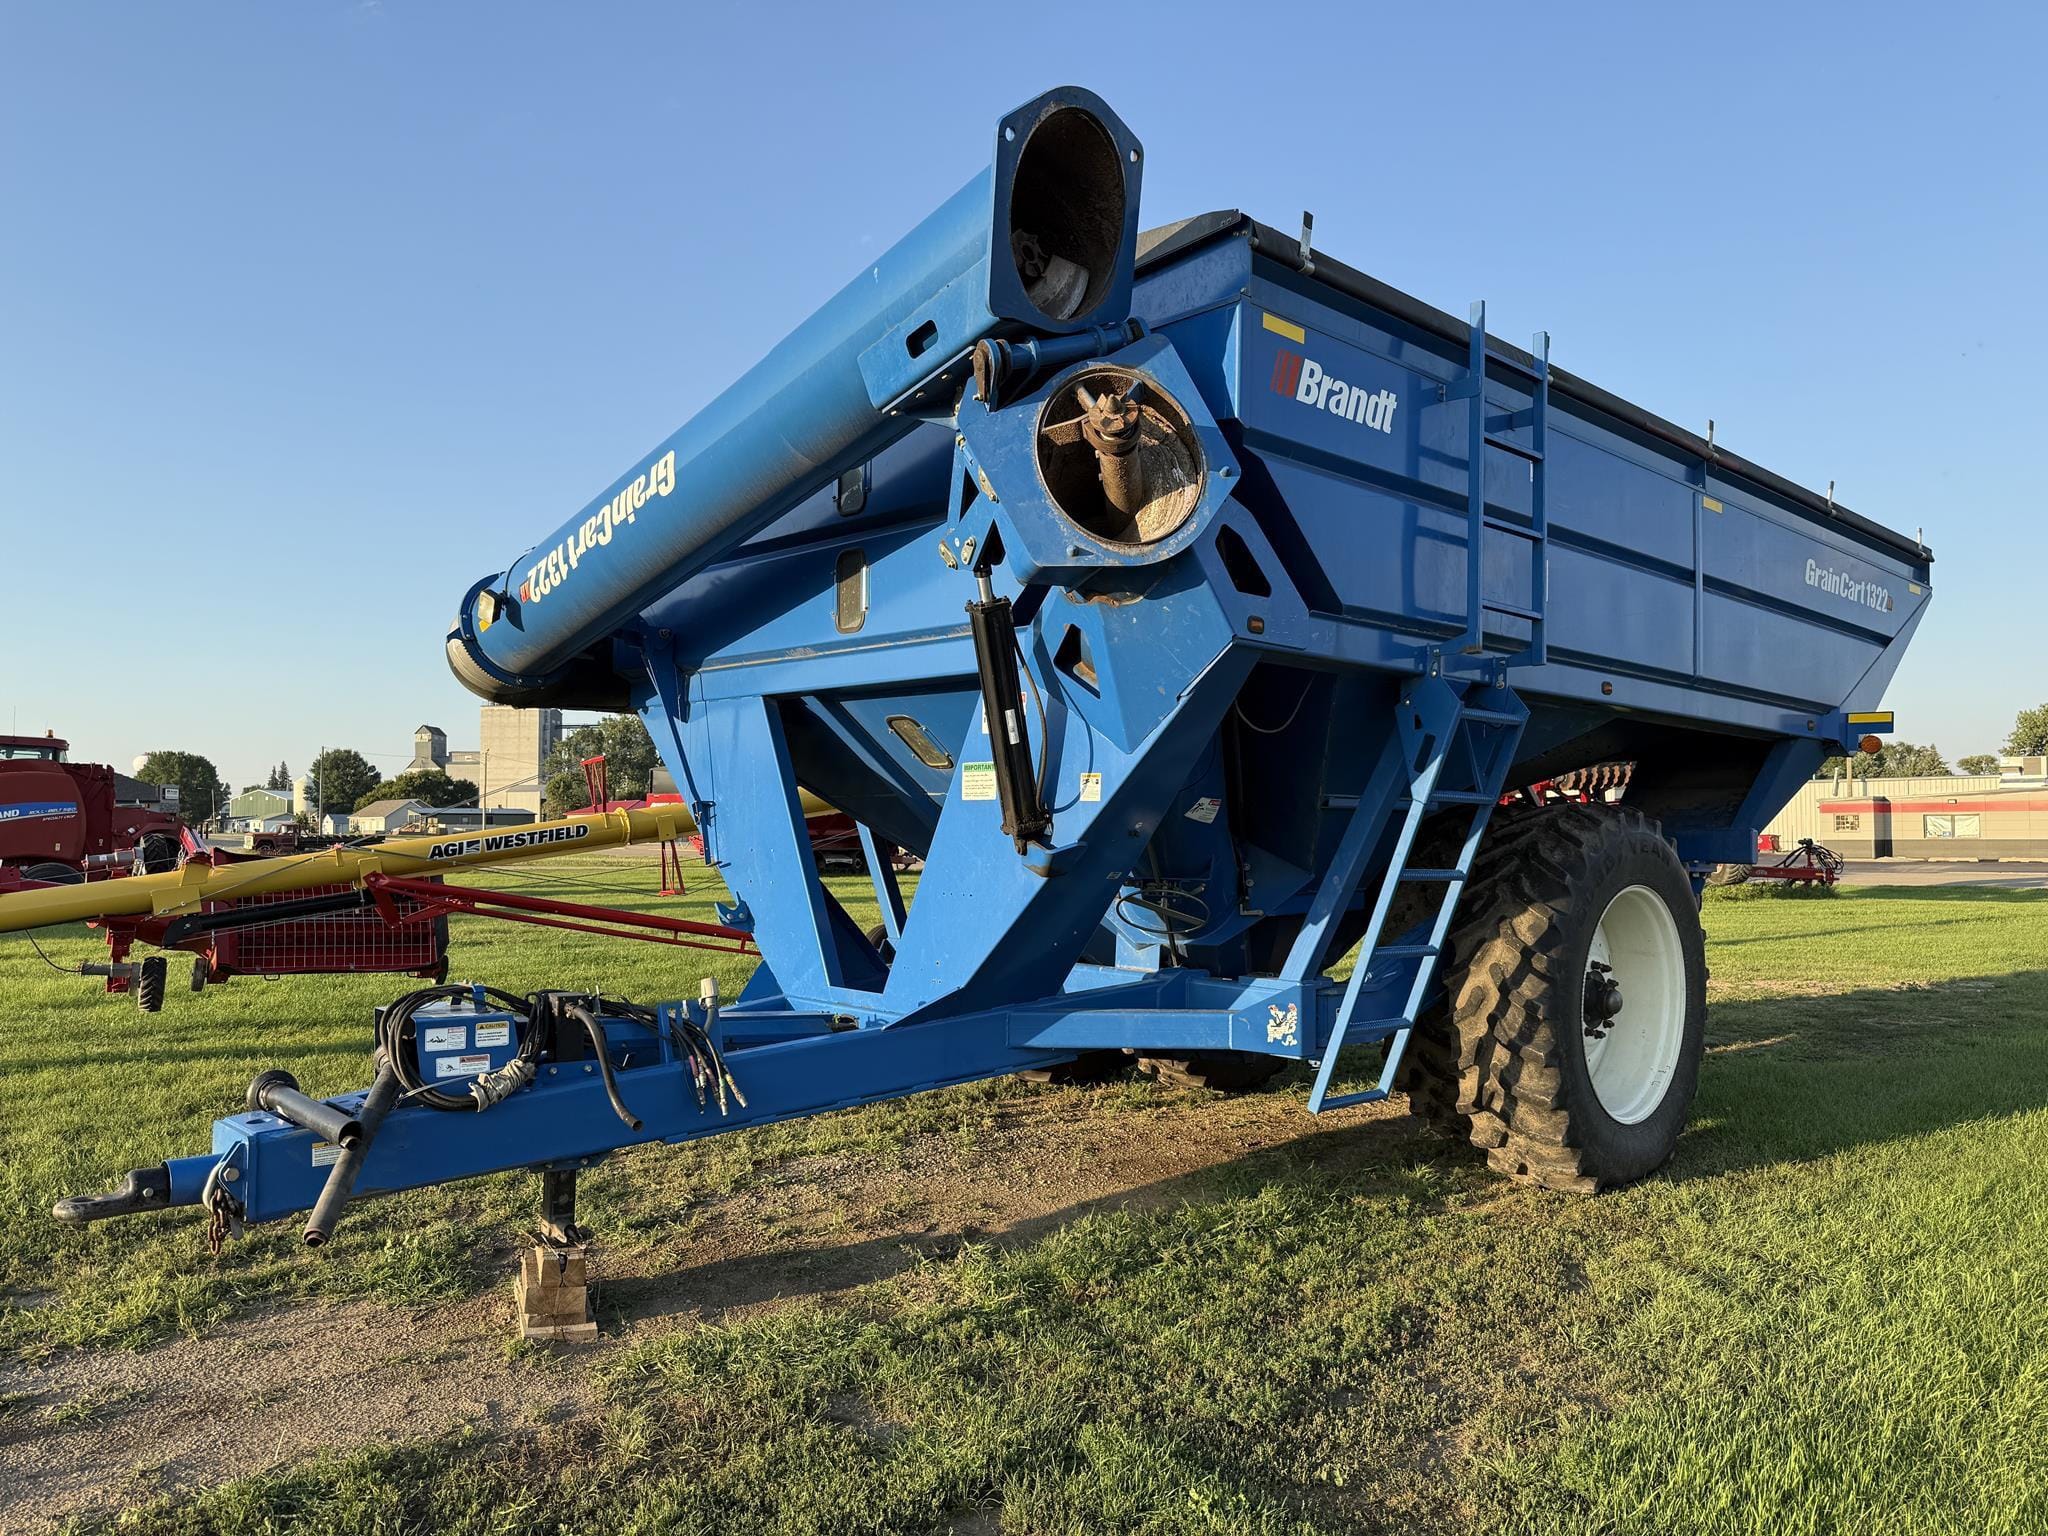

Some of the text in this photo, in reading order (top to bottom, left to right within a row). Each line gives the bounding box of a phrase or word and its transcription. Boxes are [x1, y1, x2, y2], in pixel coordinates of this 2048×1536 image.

[1296, 358, 1398, 434] Brandt
[567, 450, 676, 570] GrainCart
[1805, 558, 1865, 605] GrainCart
[429, 824, 588, 860] AGI WESTFIELD
